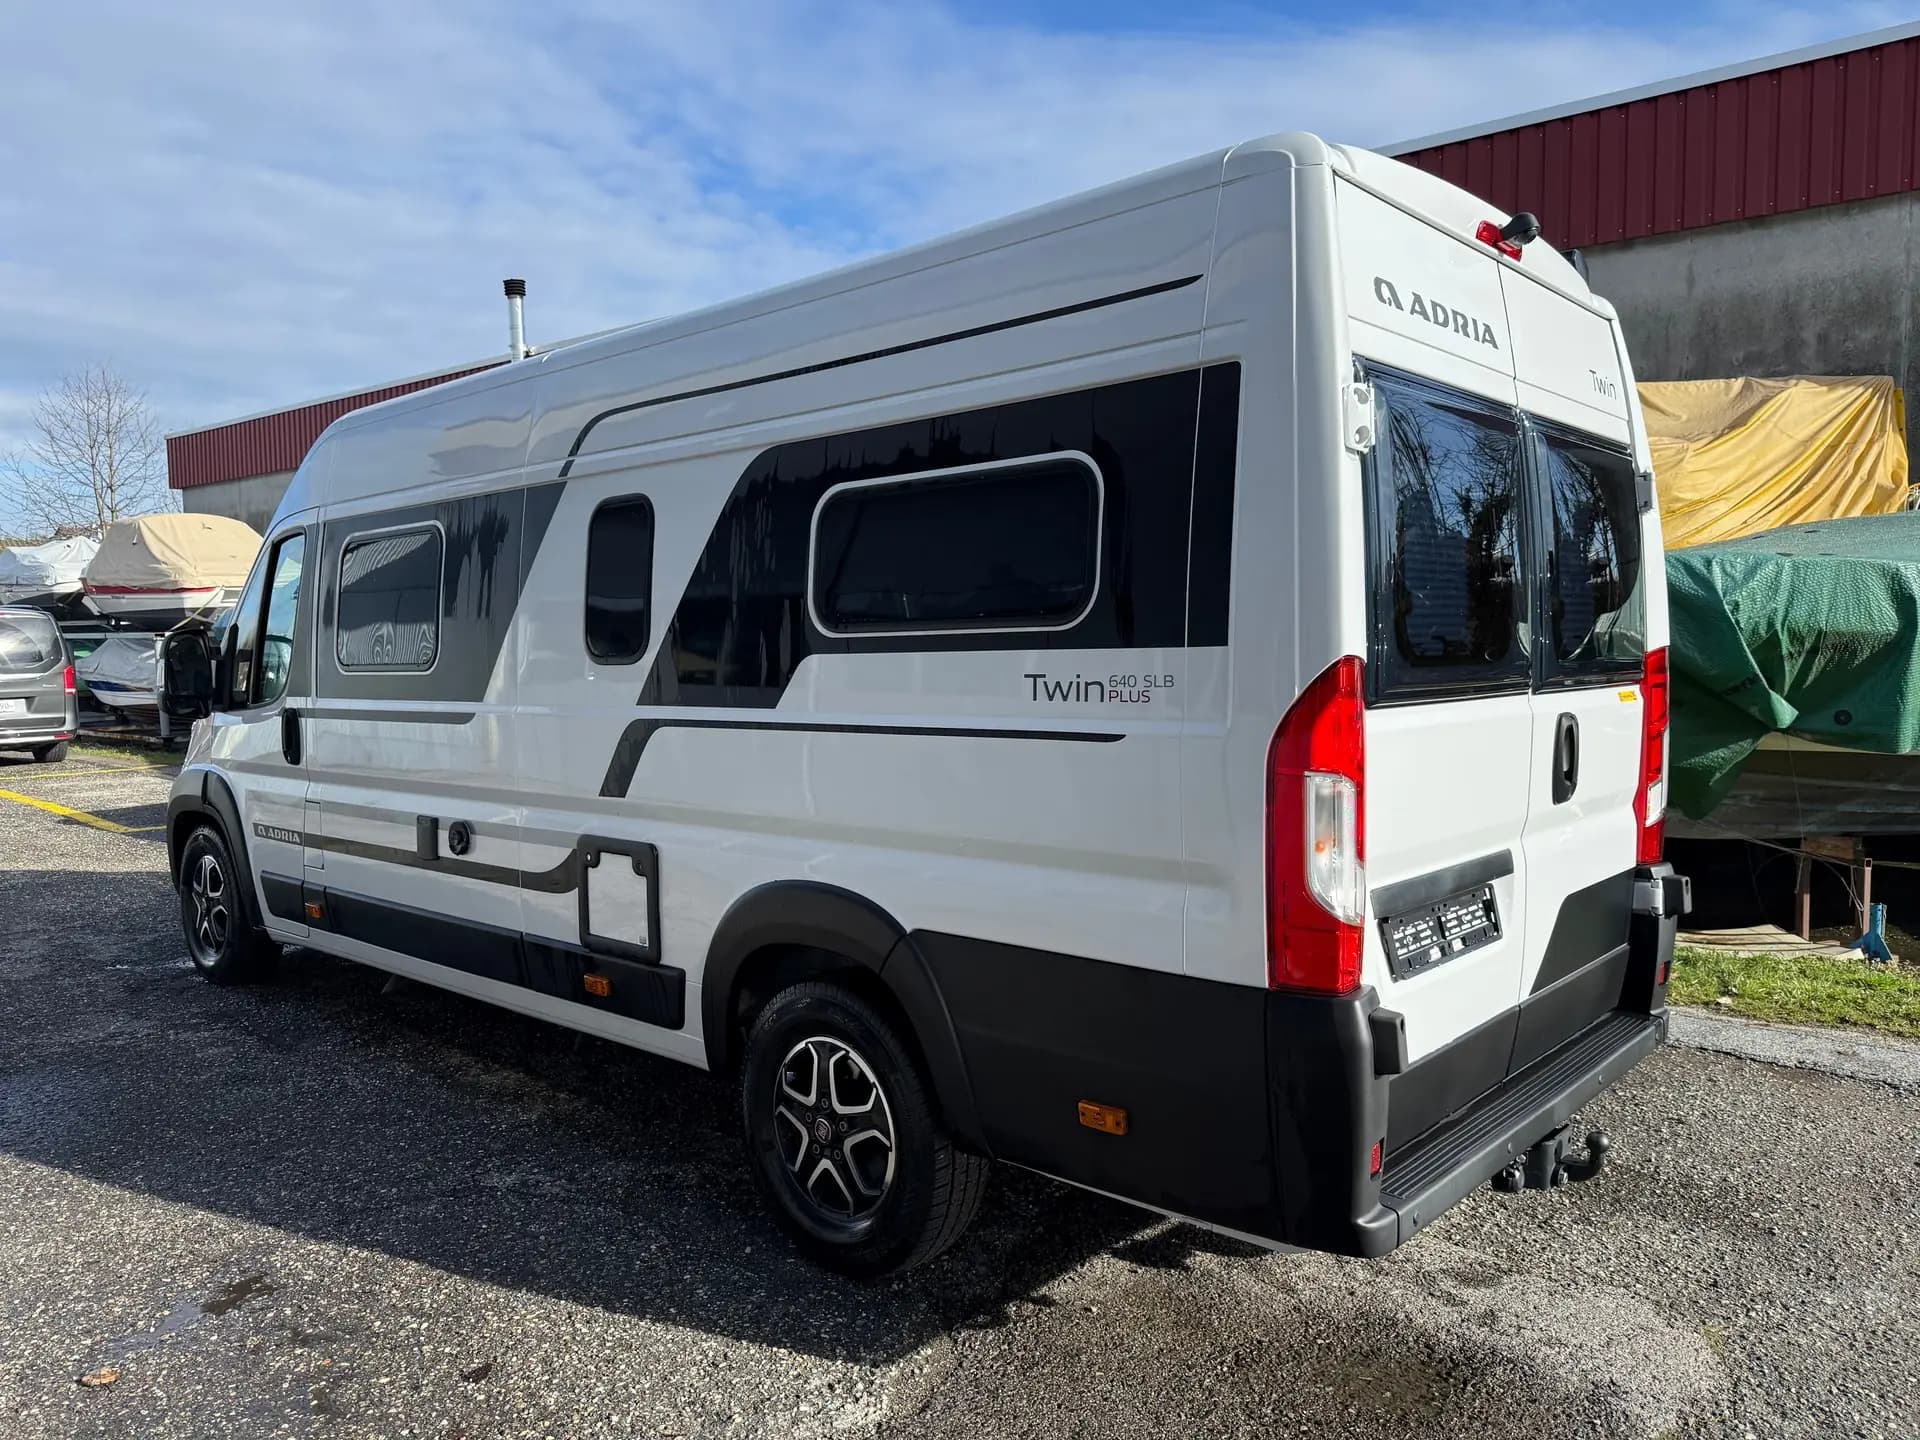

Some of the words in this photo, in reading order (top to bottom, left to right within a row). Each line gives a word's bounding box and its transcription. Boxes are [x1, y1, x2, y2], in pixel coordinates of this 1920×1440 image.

[1410, 292, 1499, 350] ADRIA
[1589, 369, 1617, 400] Twin
[1024, 673, 1104, 702] Twin
[1108, 674, 1137, 688] 640
[1143, 674, 1174, 688] SLB
[1108, 689, 1151, 703] PLUS
[267, 828, 300, 844] ADRIA
